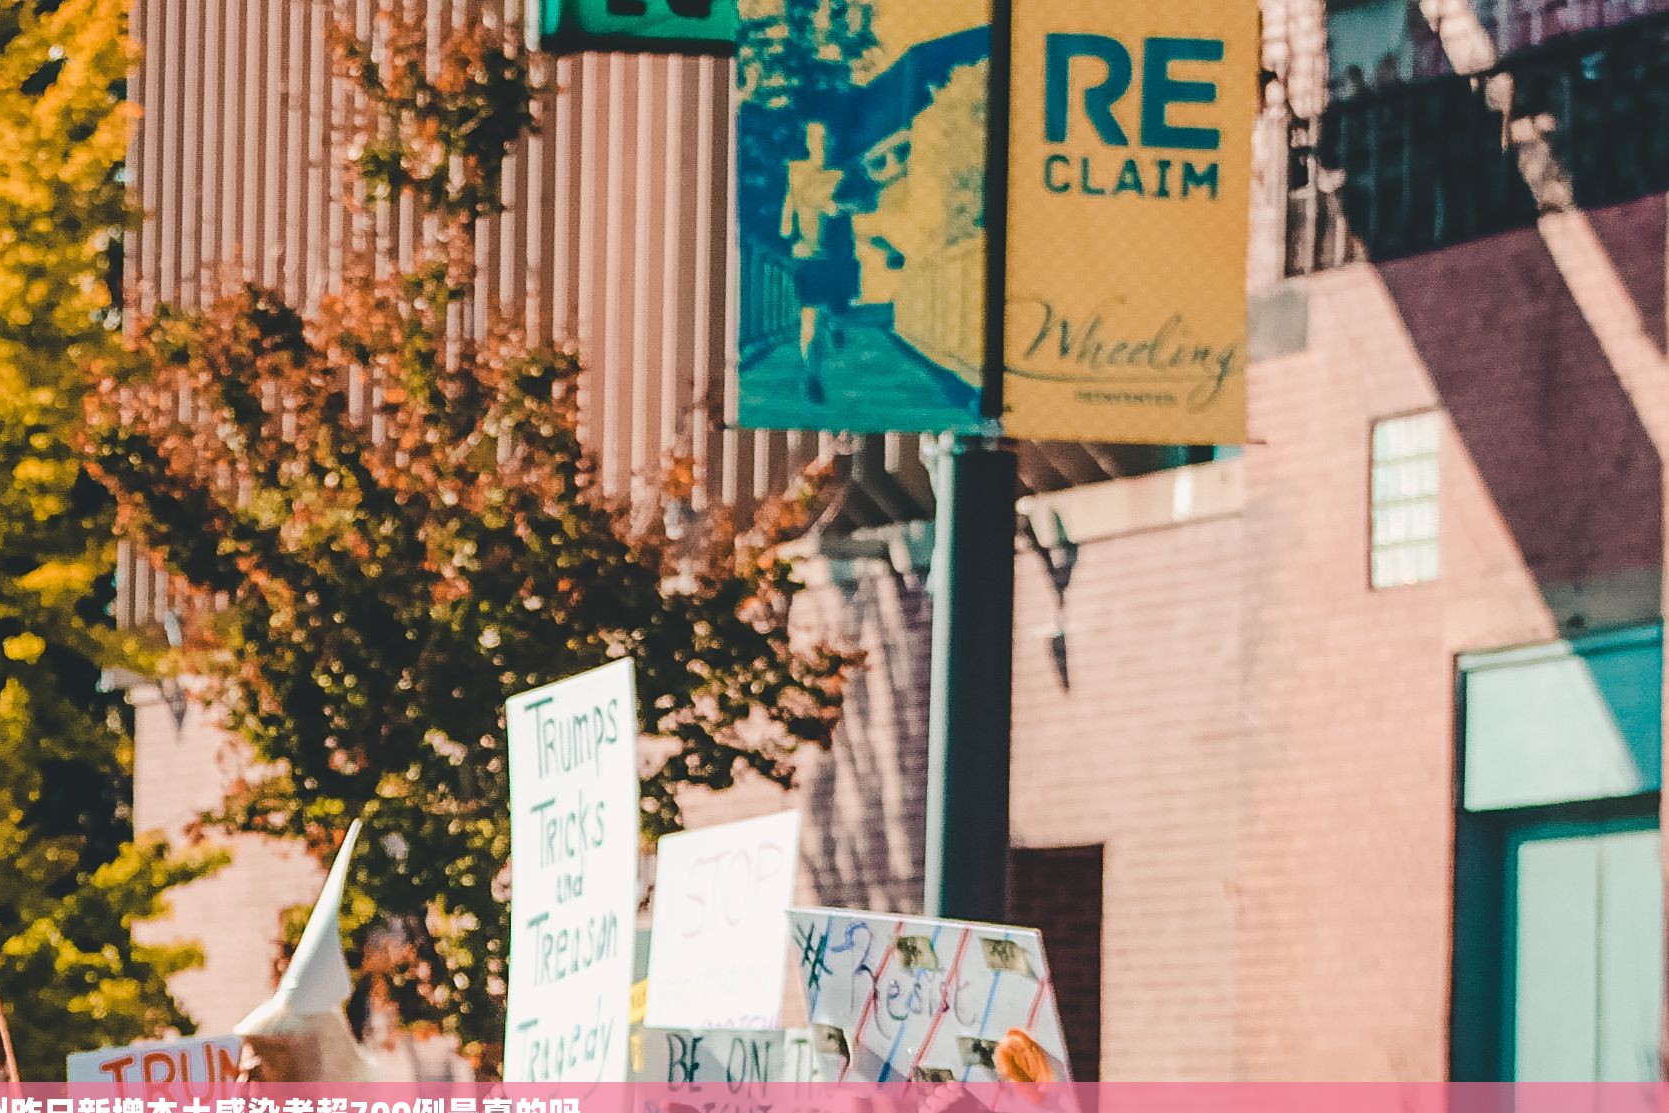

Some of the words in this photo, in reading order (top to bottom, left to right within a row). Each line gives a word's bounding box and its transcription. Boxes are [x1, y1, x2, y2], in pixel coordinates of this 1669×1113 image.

[1043, 32, 1224, 150] RE
[1044, 154, 1220, 200] CLAIM
[1008, 298, 1238, 414] Wheeling
[679, 842, 785, 940] STOP
[666, 1032, 704, 1093] BE
[726, 1037, 772, 1099] ON
